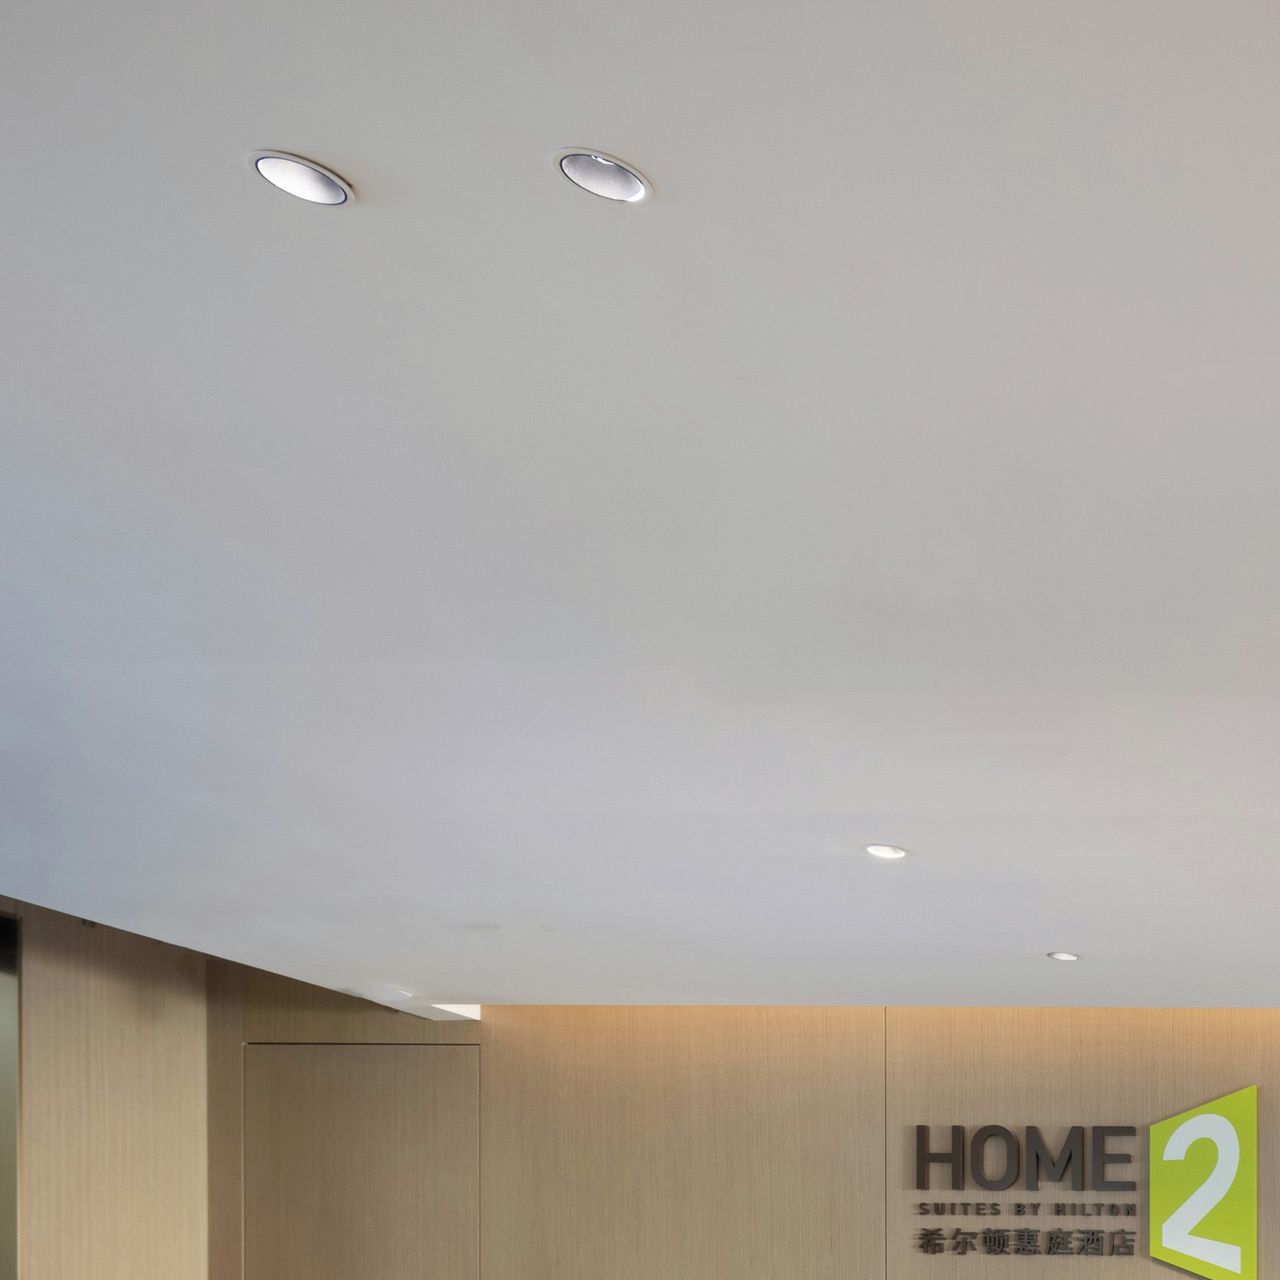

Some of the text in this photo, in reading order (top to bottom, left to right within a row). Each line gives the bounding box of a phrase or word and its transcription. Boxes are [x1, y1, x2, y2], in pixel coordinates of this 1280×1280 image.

[916, 1113, 1242, 1275] HOME 2
[918, 1202, 1137, 1217] SUITES BY HILTON
[917, 1228, 1137, 1257] 希尔顿惠庭酒店
